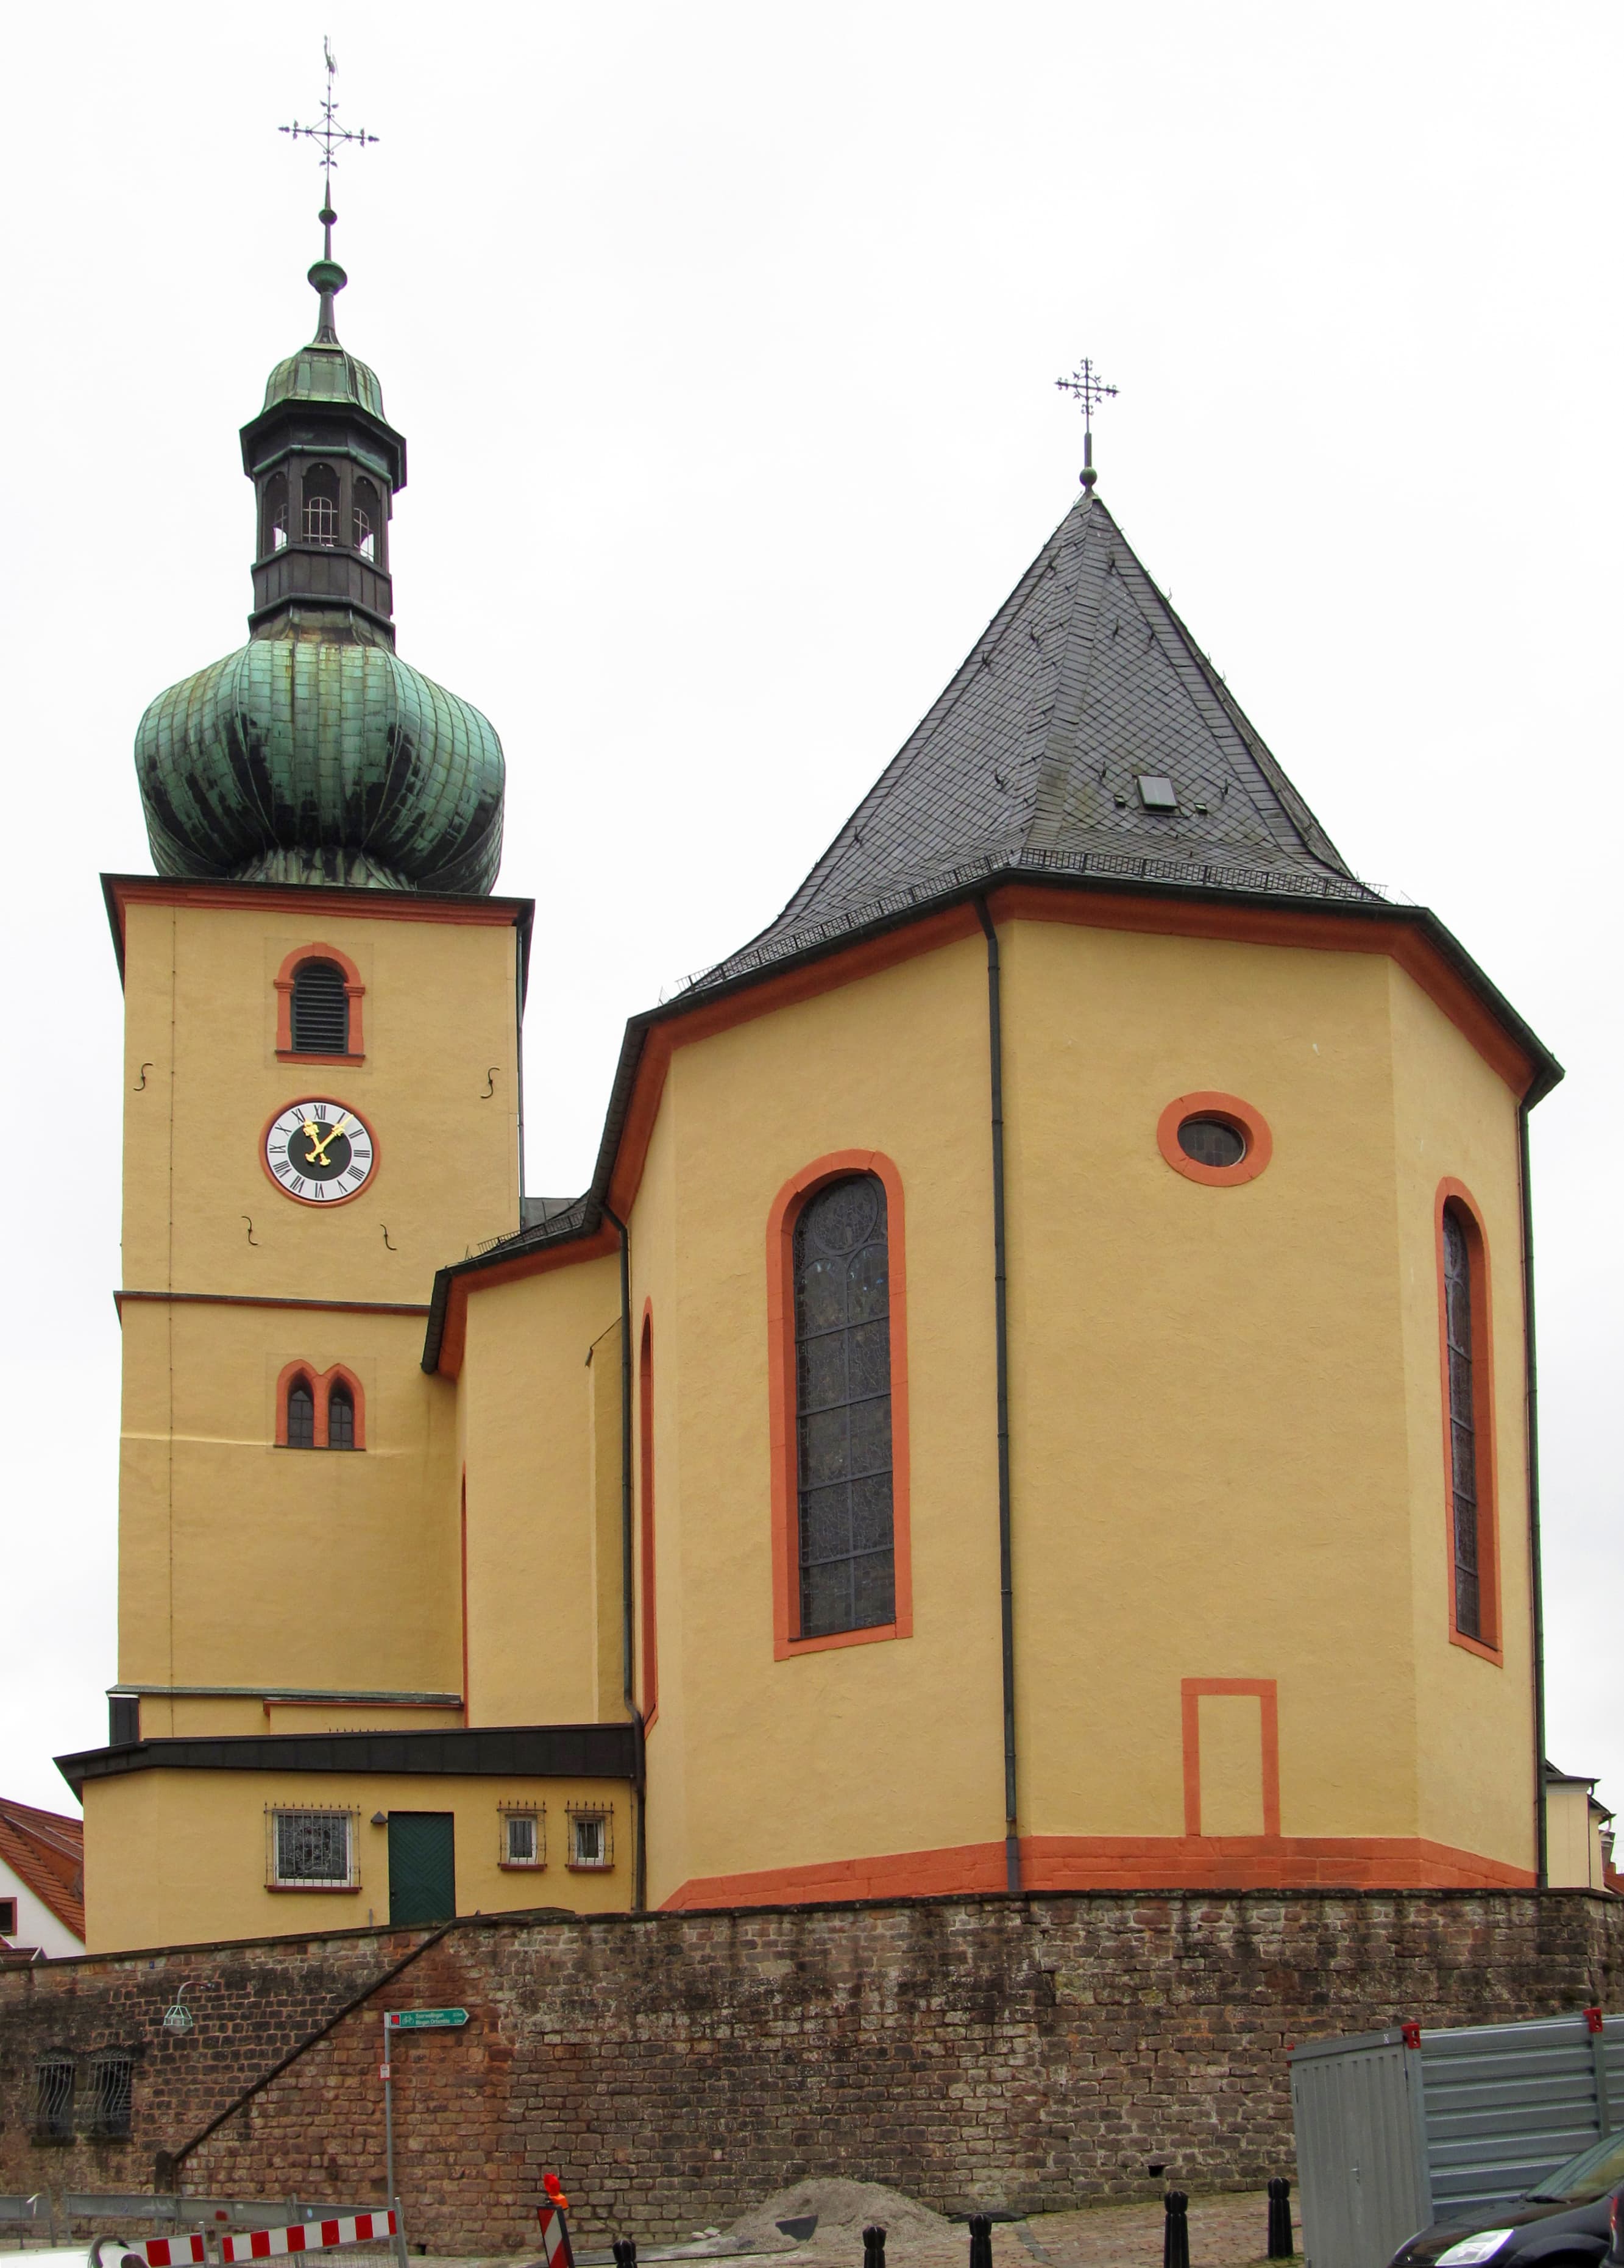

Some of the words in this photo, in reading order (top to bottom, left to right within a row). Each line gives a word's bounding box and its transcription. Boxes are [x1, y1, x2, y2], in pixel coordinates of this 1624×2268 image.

[314, 1104, 326, 1120] XII
[337, 1112, 346, 1124] I
[274, 1123, 292, 1136] X
[349, 1129, 364, 1139] II
[269, 1144, 286, 1153] IX
[353, 1150, 371, 1158] III
[272, 1160, 292, 1178] VIII
[347, 1165, 366, 1181] IIII
[289, 1175, 305, 1193] VII
[314, 1182, 324, 1198] VI
[337, 1179, 348, 1195] V
